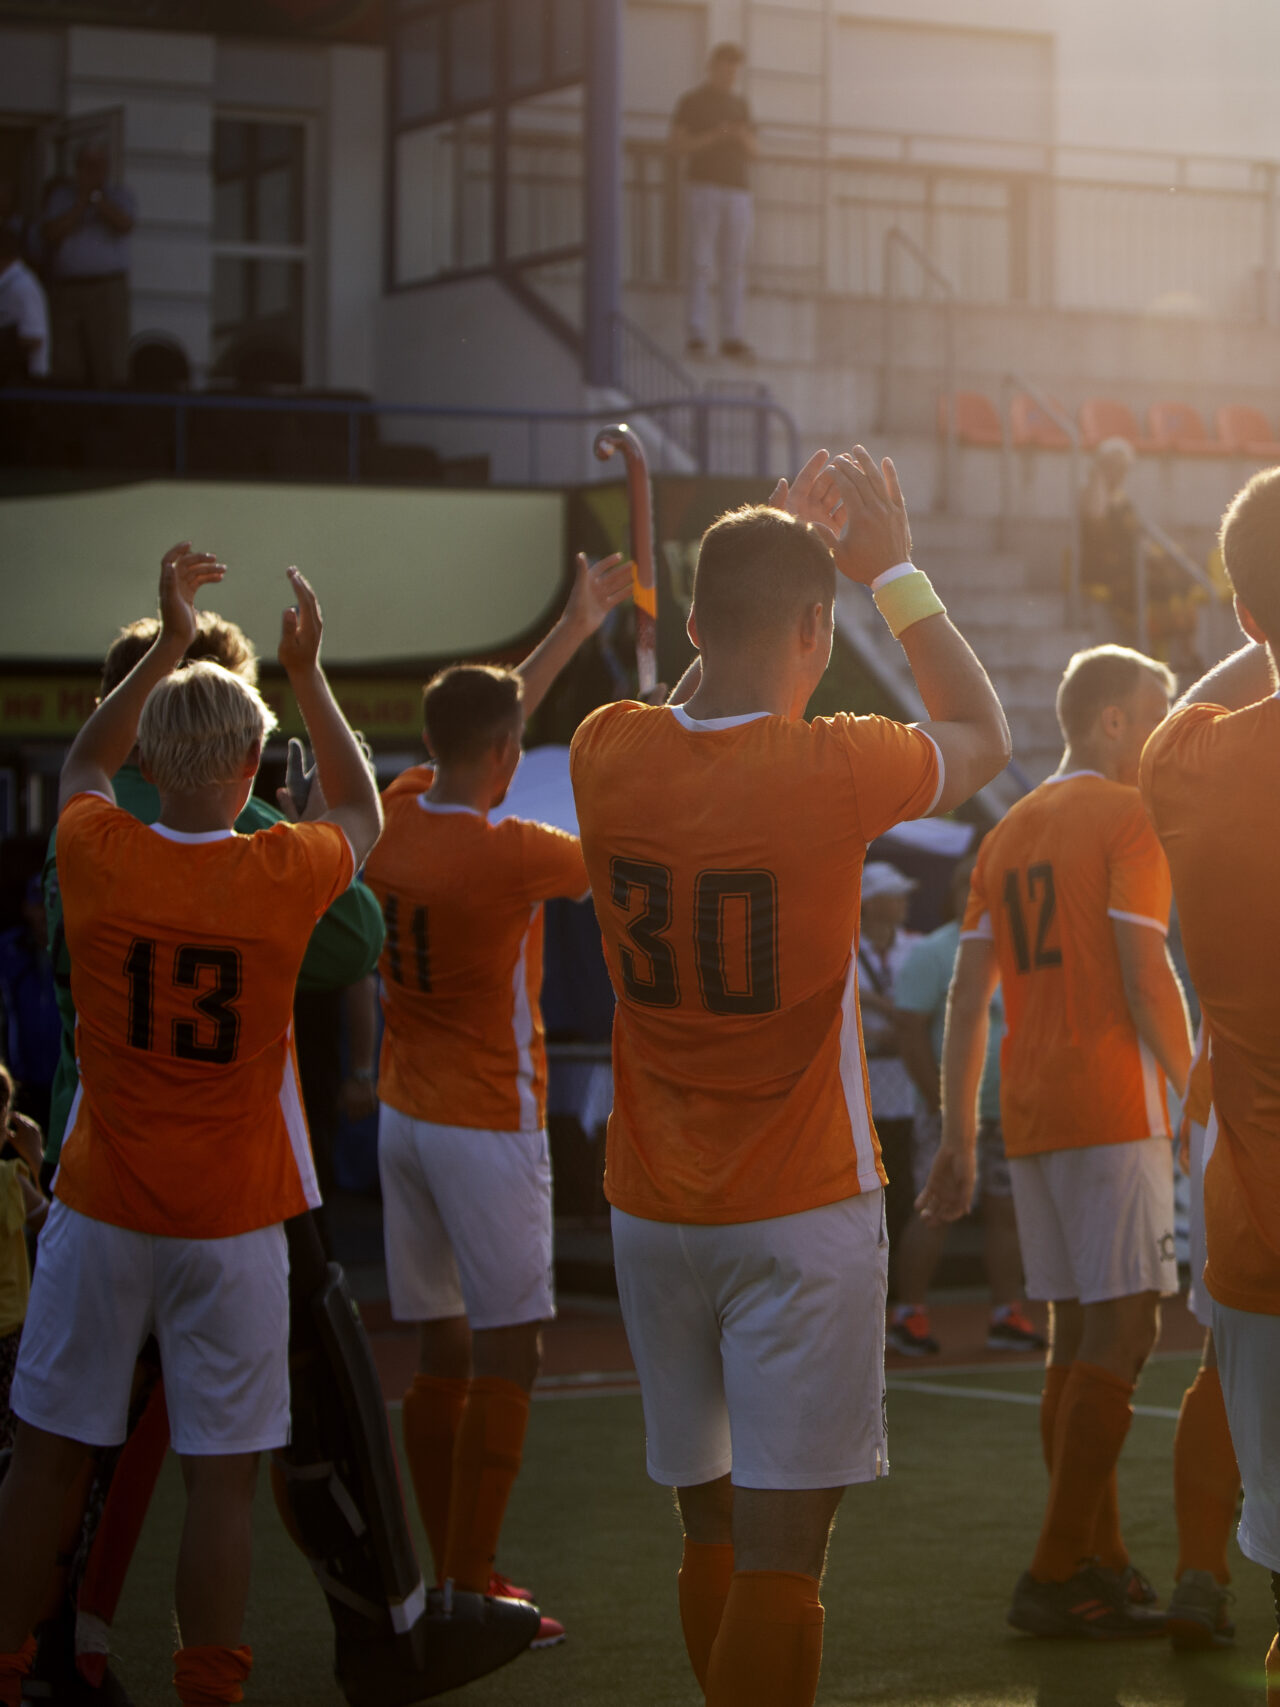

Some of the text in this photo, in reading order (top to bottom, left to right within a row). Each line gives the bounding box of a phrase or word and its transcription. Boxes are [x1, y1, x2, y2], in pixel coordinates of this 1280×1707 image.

[385, 893, 433, 993] 11
[610, 856, 780, 1014] 30
[1003, 862, 1062, 975] 12
[123, 938, 241, 1064] 13
